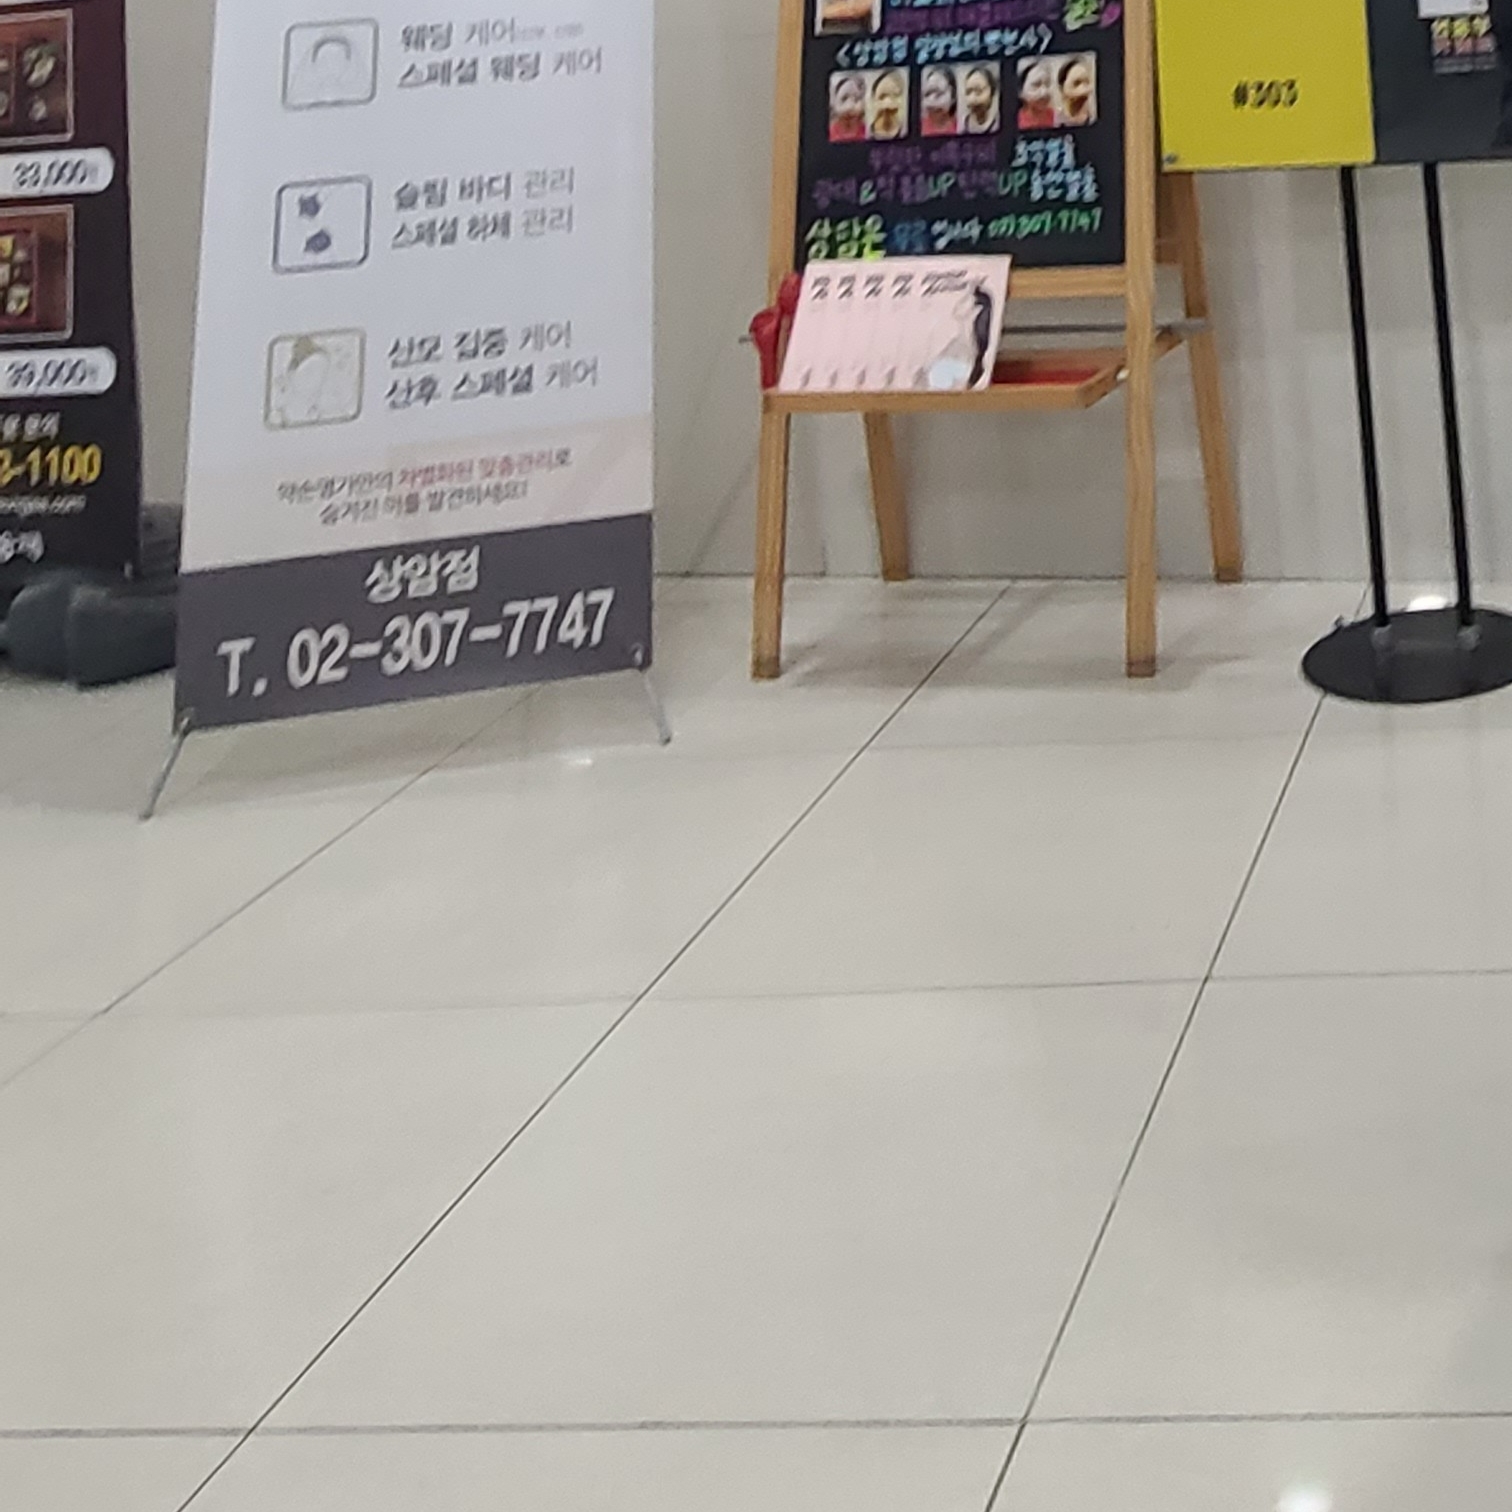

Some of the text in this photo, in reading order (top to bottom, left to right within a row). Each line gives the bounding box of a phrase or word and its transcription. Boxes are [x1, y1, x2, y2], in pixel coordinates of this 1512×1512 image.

[552, 45, 602, 76] 케어
[524, 166, 575, 199] 관리
[521, 204, 574, 237] 관리
[518, 319, 572, 353] 케어
[545, 357, 599, 389] 케어
[364, 543, 481, 604] 상암점
[215, 586, 616, 698] T. 02-307-7747
